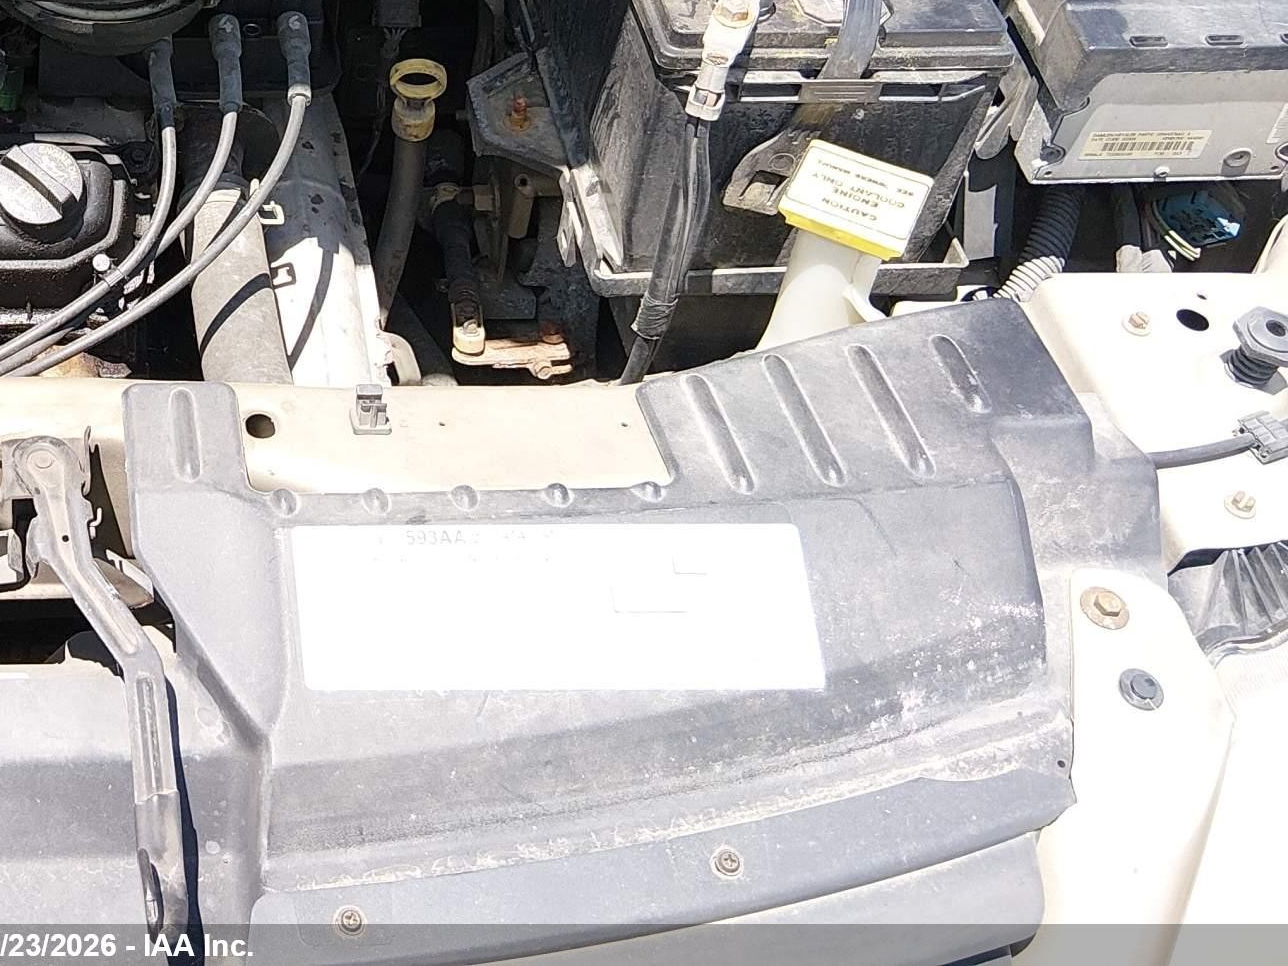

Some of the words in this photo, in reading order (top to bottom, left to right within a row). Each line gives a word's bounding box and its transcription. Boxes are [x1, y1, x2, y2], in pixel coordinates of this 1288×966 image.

[821, 196, 878, 222] CAUTION
[832, 187, 879, 209] ENGINE
[849, 185, 906, 209] COOLANT
